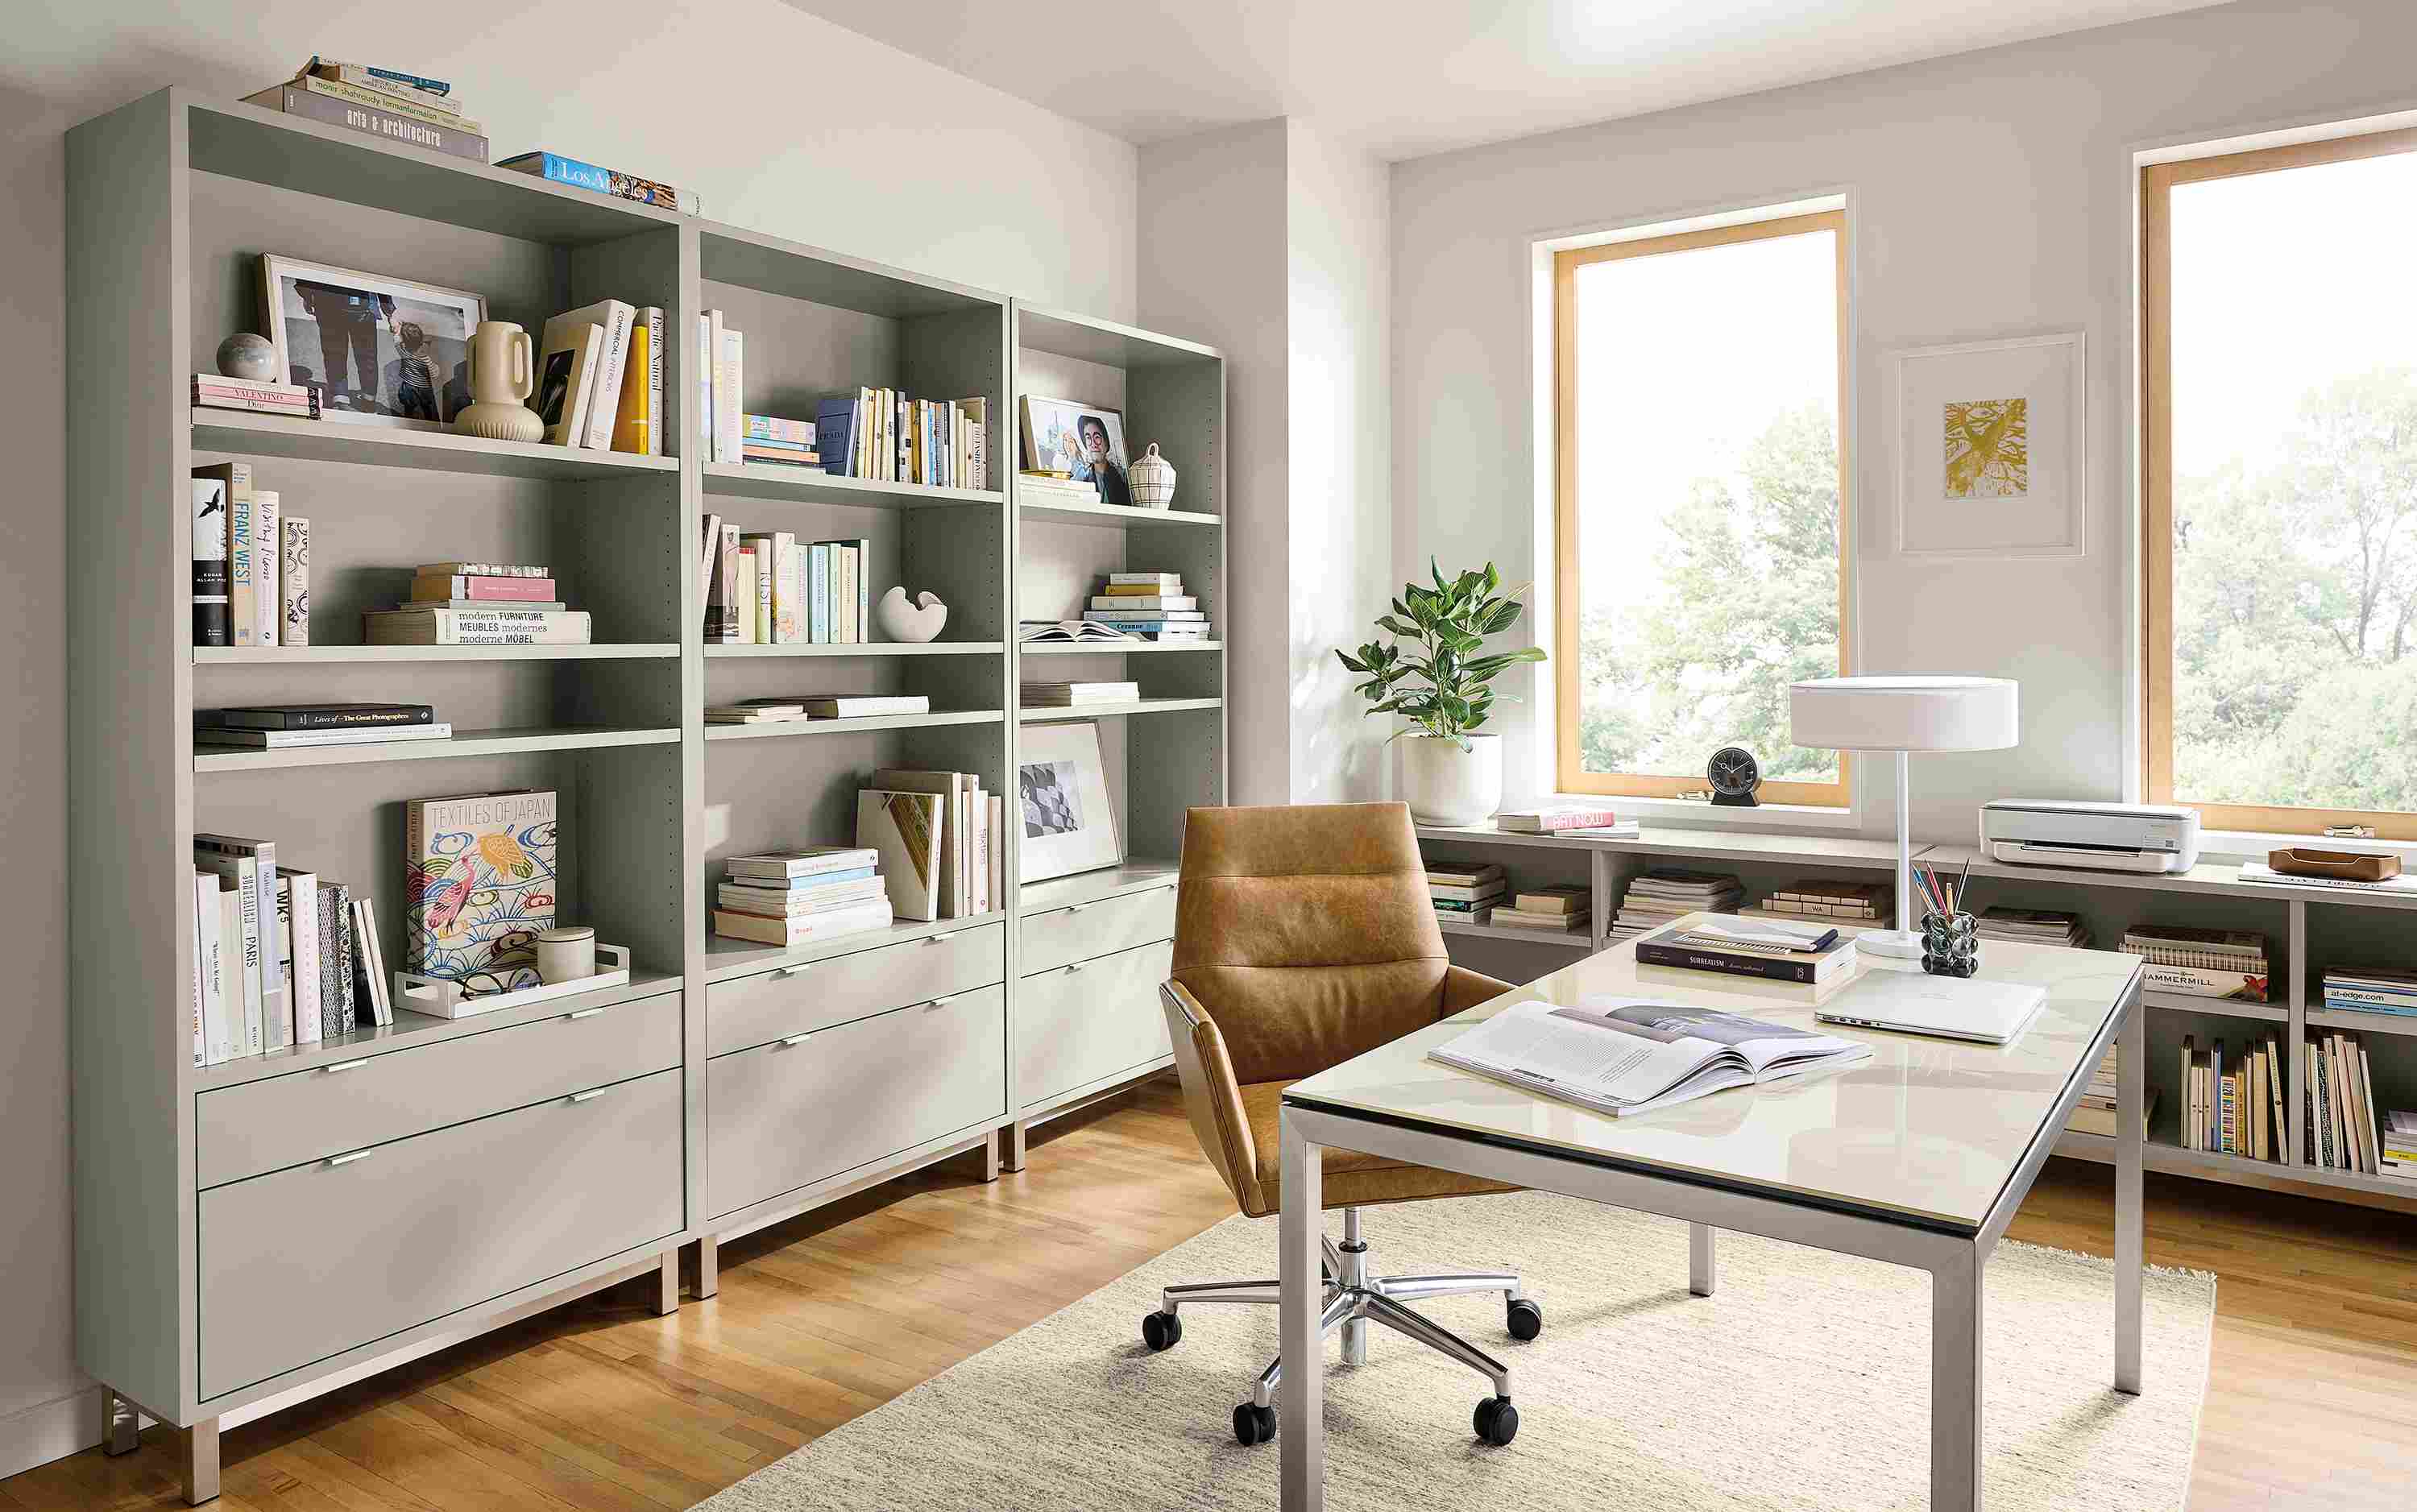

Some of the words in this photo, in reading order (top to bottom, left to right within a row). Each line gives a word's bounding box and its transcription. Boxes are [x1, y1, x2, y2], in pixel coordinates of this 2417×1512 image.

[347, 109, 367, 128] arts
[372, 117, 379, 130] &
[383, 118, 442, 147] architecture
[563, 161, 591, 184] Los
[594, 172, 648, 201] Angeles
[651, 316, 663, 350] Pacific
[651, 354, 663, 391] Natural
[234, 502, 251, 546] FRANZ
[234, 549, 251, 586] WEST
[458, 612, 497, 621] modern
[500, 612, 545, 622] FURNITURE
[458, 623, 499, 632] MEUBLES
[501, 623, 548, 632] modernes
[459, 634, 503, 644] moderne
[431, 804, 491, 827] TEXTILES
[495, 802, 510, 822] OF
[510, 798, 550, 821] JAPAN
[1553, 815, 1573, 828] ART
[1575, 812, 1603, 826] NOW
[245, 936, 258, 967] PARIS
[1689, 956, 1725, 967] SURREALISM
[2331, 990, 2386, 1001] at-edge.com
